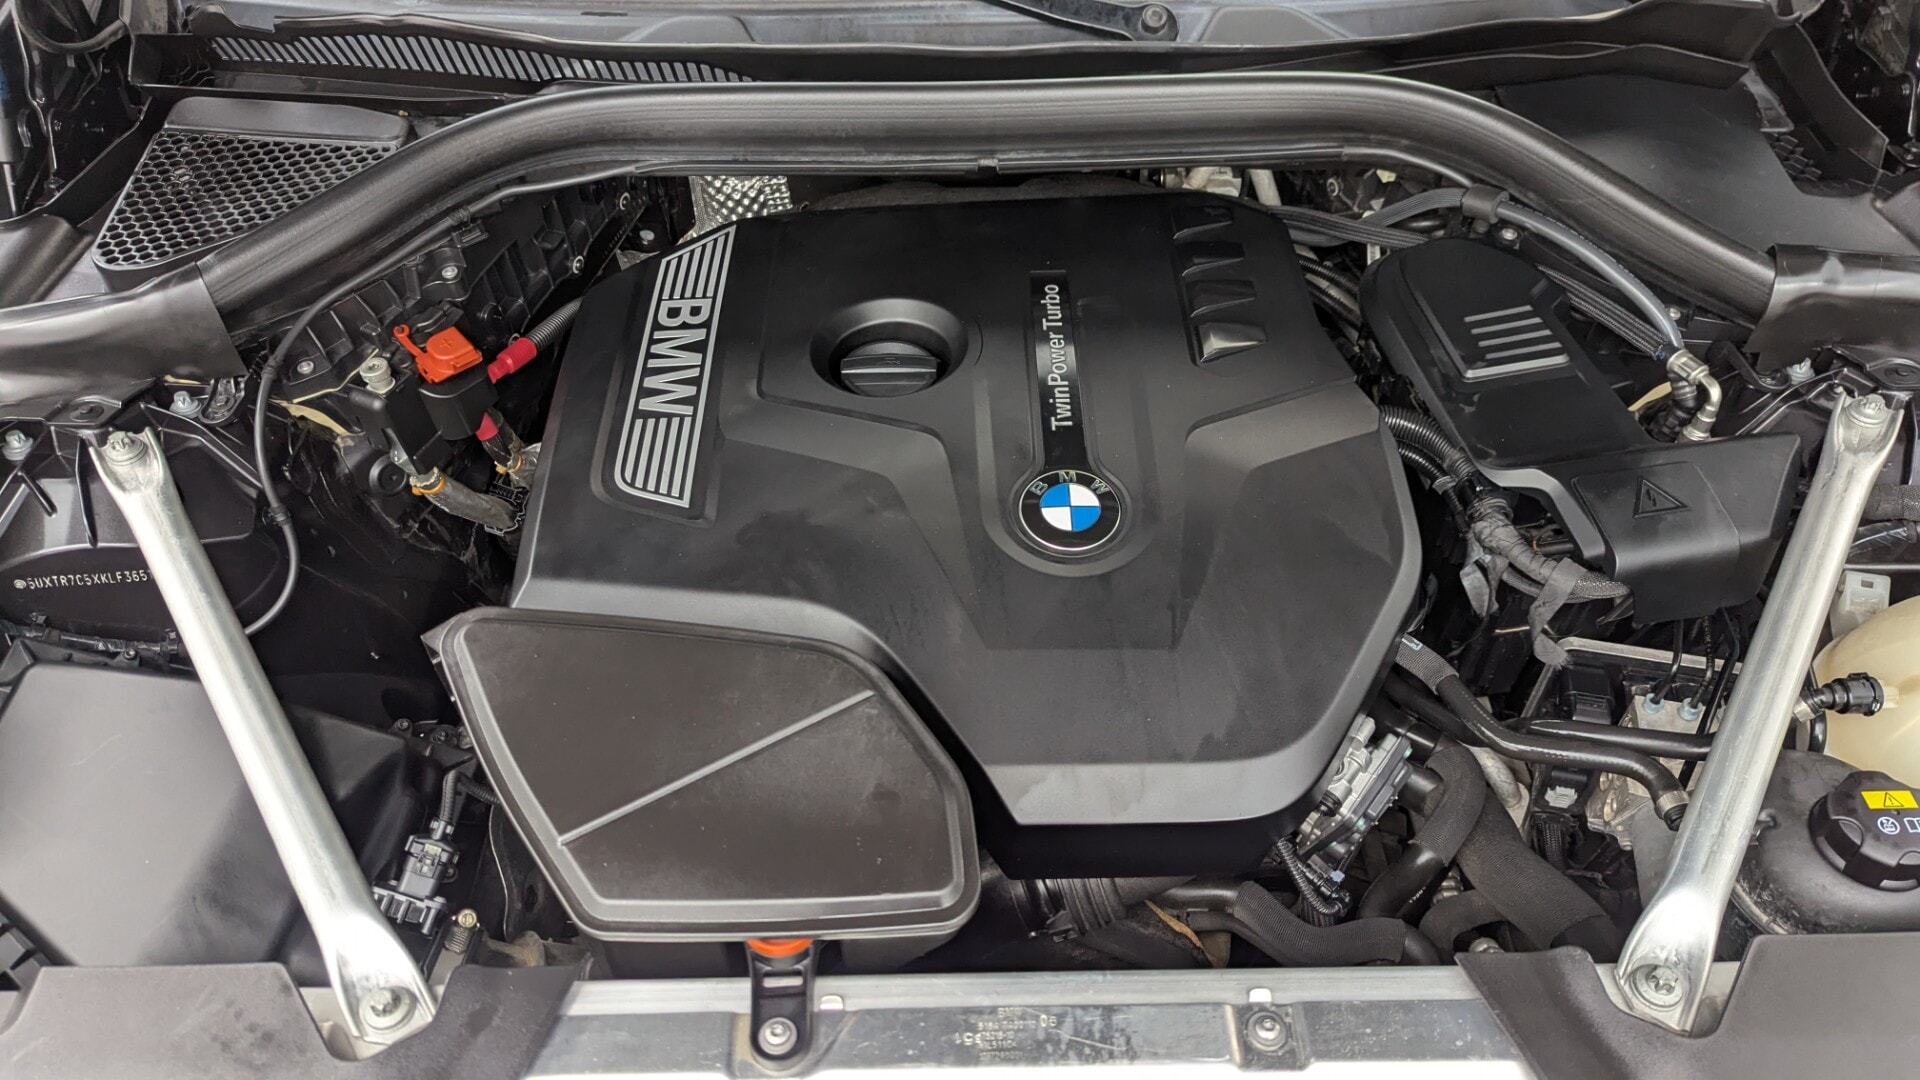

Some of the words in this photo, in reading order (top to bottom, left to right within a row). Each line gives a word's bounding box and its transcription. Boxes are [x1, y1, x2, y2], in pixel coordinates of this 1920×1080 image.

[1040, 284, 1063, 331] Turbo
[638, 297, 713, 416] BMW
[1047, 331, 1074, 431] TwinPower
[1029, 471, 1110, 496] BMW
